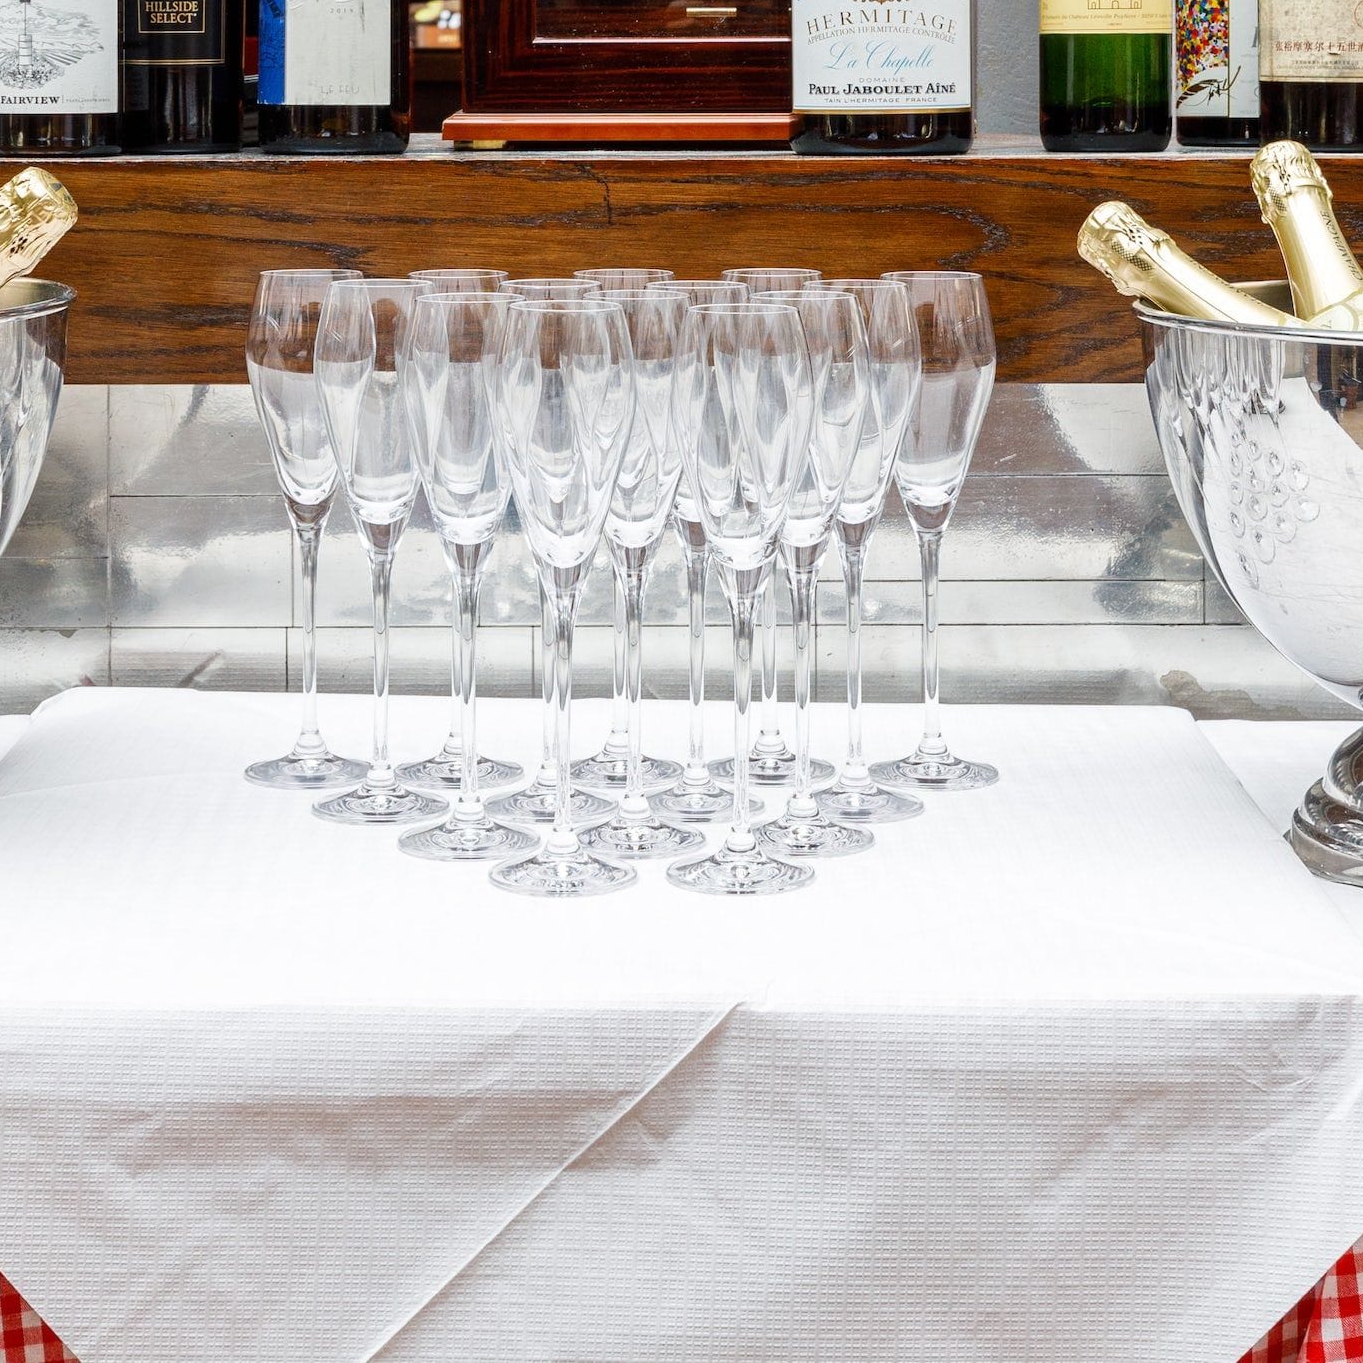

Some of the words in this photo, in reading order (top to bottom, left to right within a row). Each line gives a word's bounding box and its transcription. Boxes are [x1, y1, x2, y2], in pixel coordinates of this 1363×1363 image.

[145, 0, 199, 13] HILLSIDE
[806, 8, 958, 36] HERMITAGE
[806, 26, 856, 46] APPELLATION
[857, 25, 911, 35] HERMITAGE
[822, 41, 858, 71] La
[864, 38, 936, 76] Chapelle
[808, 82, 840, 95] PAUL
[842, 83, 923, 95] JABOULET
[0, 95, 61, 105] FAIRVIEW
